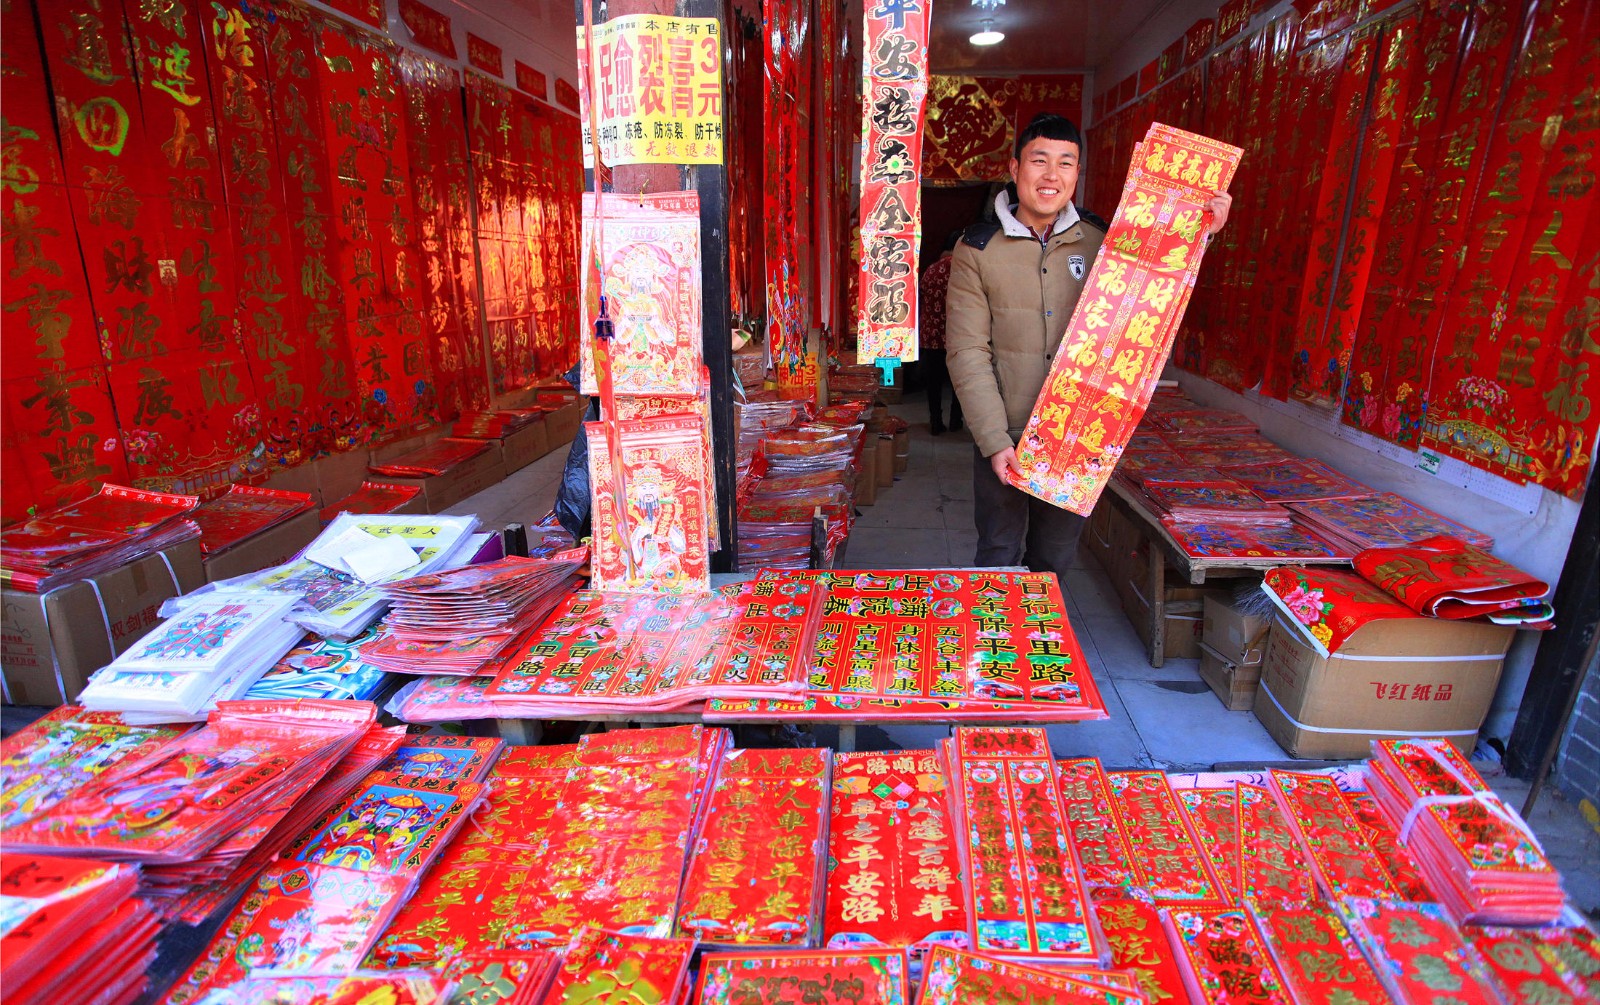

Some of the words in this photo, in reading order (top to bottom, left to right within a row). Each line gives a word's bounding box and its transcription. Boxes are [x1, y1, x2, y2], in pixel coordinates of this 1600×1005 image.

[645, 19, 718, 35] 本店有售
[513, 603, 590, 677] 日行千里路
[760, 625, 798, 681] 六畜兴旺
[933, 625, 965, 694] 五谷丰登
[971, 580, 1020, 681] 人车保平安
[1018, 581, 1075, 684] 日行千里路
[1369, 681, 1453, 701] 飞红纸品
